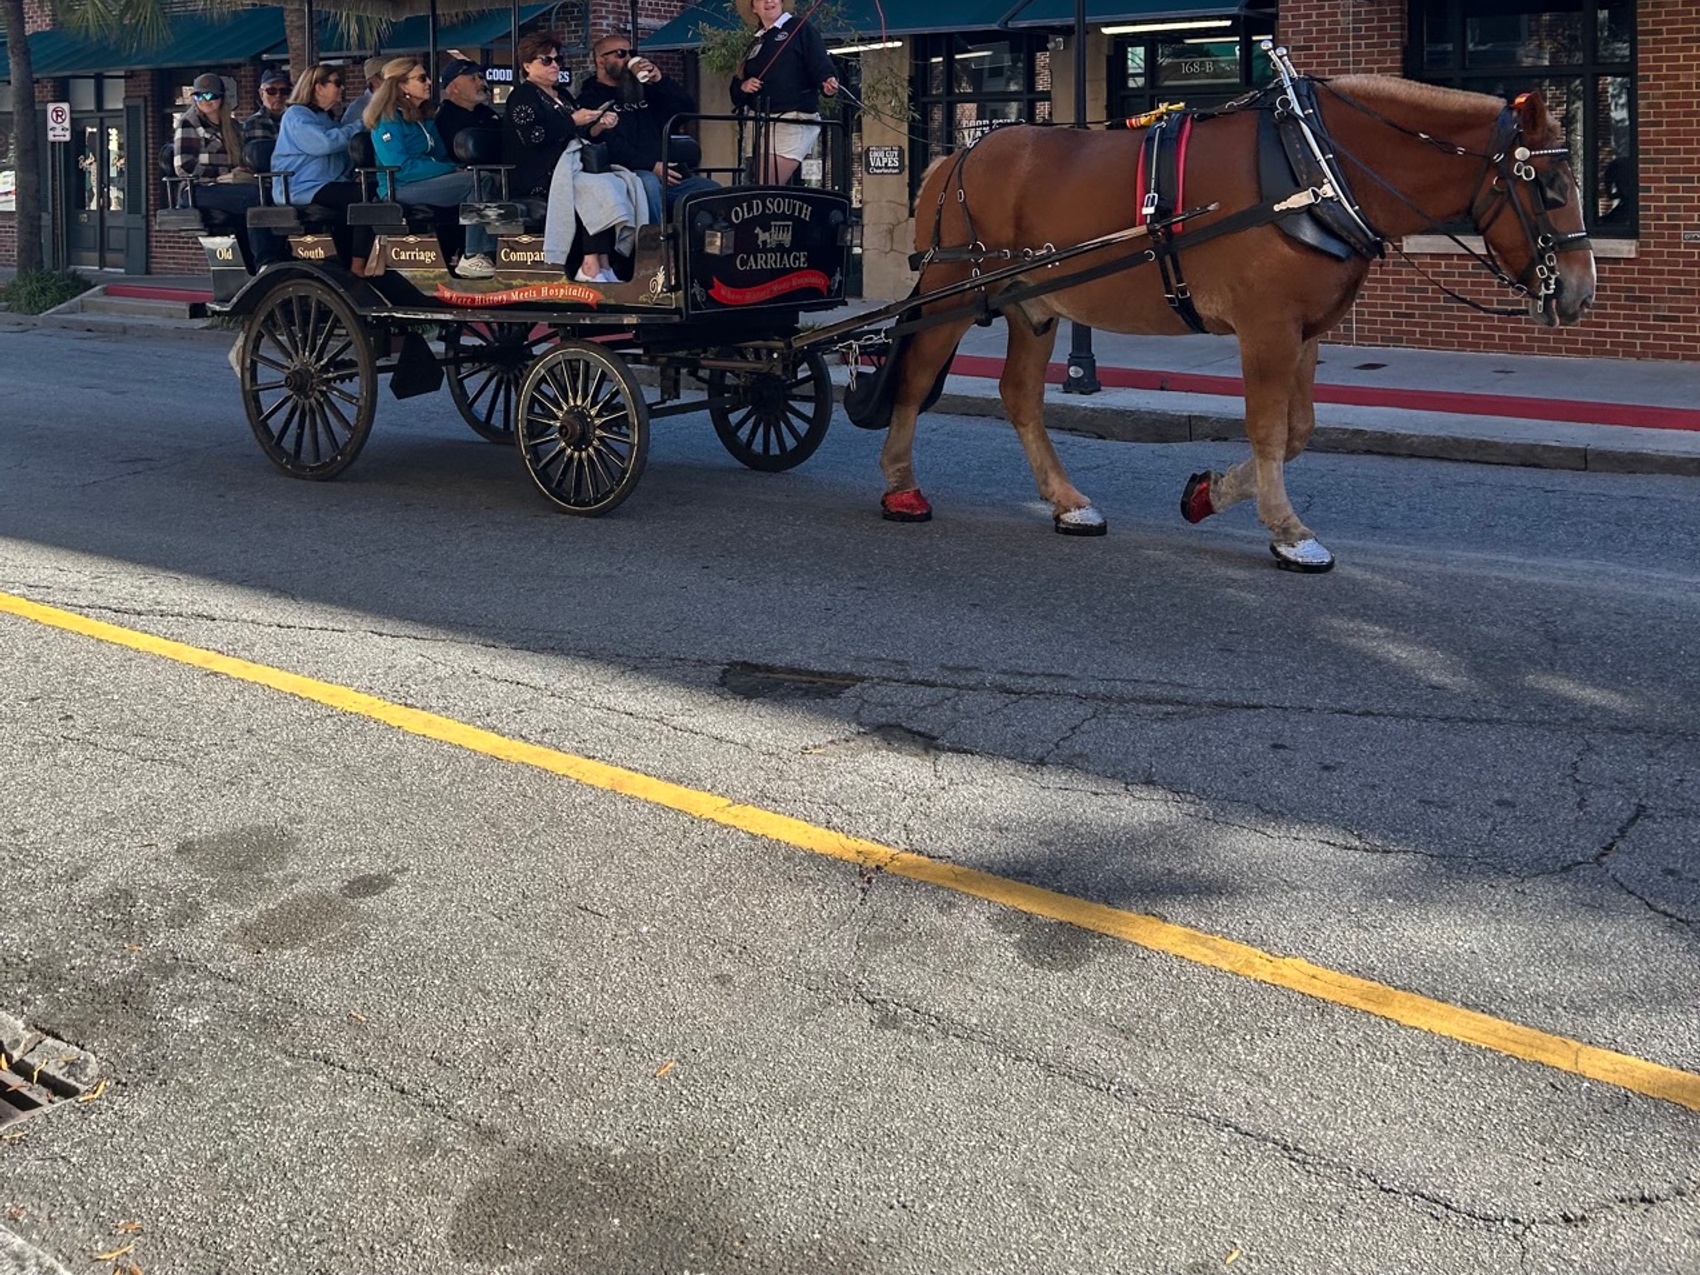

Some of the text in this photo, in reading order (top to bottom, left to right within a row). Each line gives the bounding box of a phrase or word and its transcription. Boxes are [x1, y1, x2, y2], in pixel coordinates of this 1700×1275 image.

[486, 69, 513, 81] GOOD
[1181, 61, 1214, 74] 168-B
[869, 157, 900, 167] VAPES
[731, 197, 812, 224] OLD SOUTH
[216, 247, 233, 260] Old
[297, 246, 325, 259] South
[391, 247, 437, 264] Carriage
[501, 248, 546, 265] Compa
[736, 251, 808, 271] CARRIAGE
[443, 286, 595, 305] Where History Meets Hospitality
